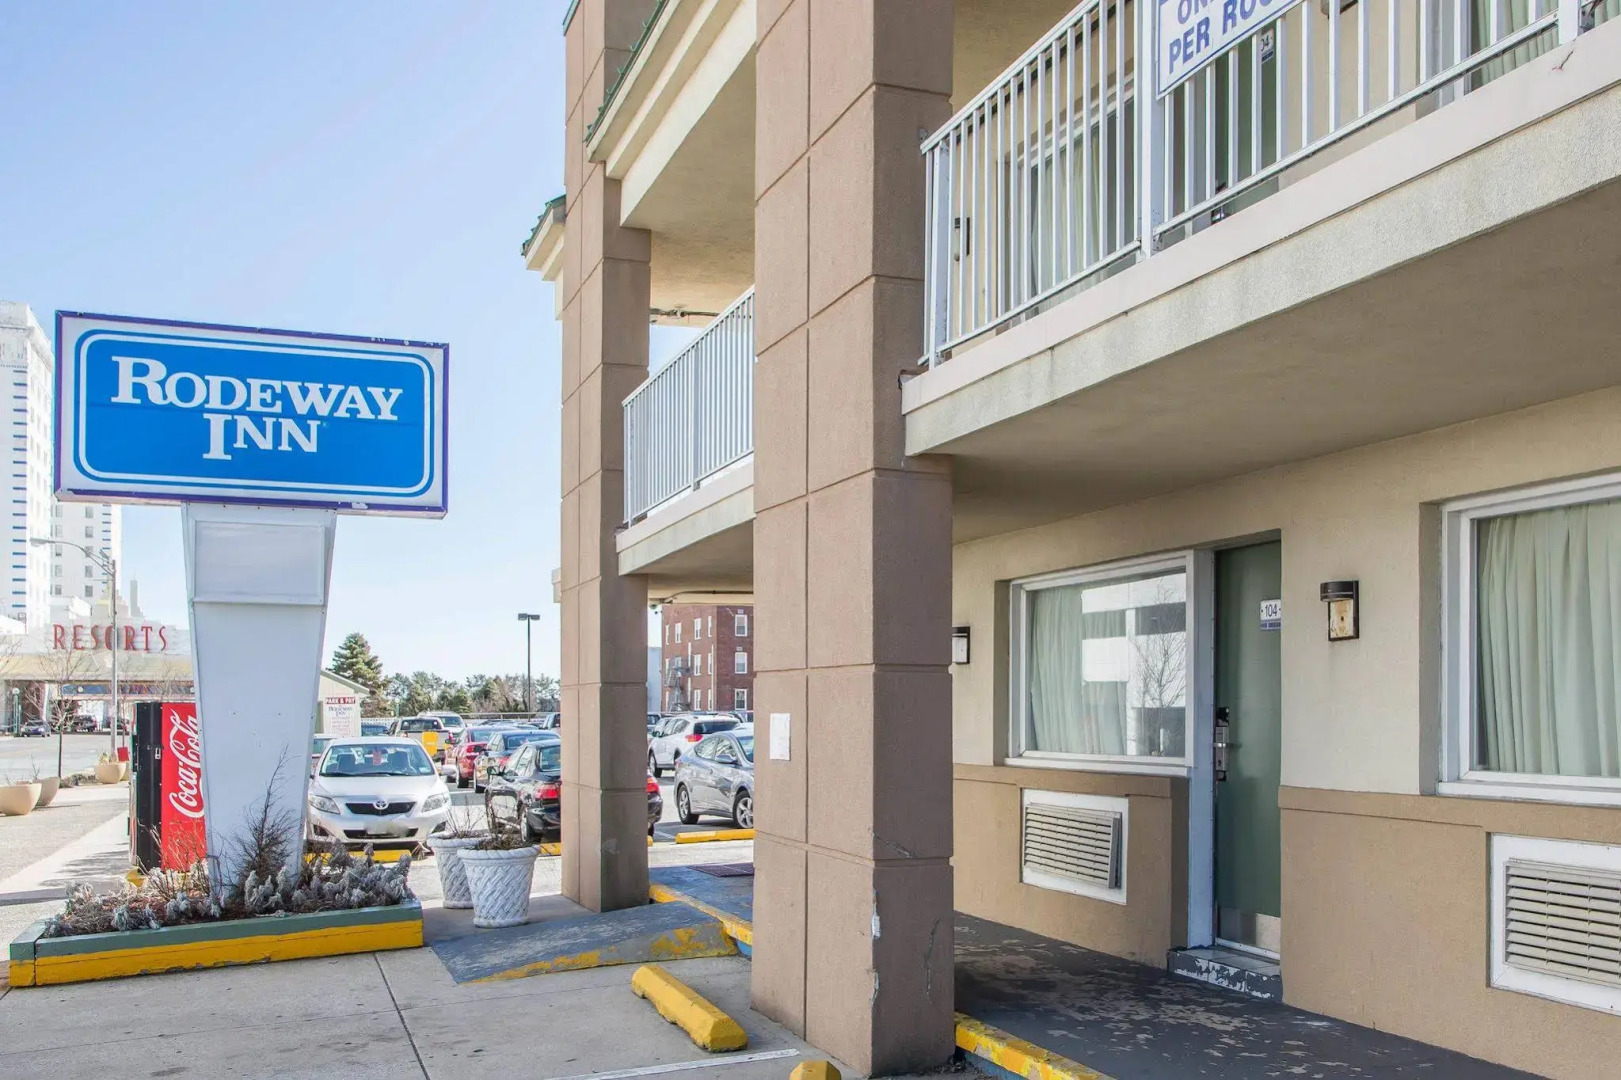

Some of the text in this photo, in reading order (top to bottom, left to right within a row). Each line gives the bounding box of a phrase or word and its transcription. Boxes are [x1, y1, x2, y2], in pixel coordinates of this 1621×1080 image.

[1169, 16, 1211, 74] PER
[110, 355, 403, 421] RODEWAY
[202, 412, 318, 461] INN
[1265, 603, 1278, 618] 104
[52, 623, 168, 652] RESORTS
